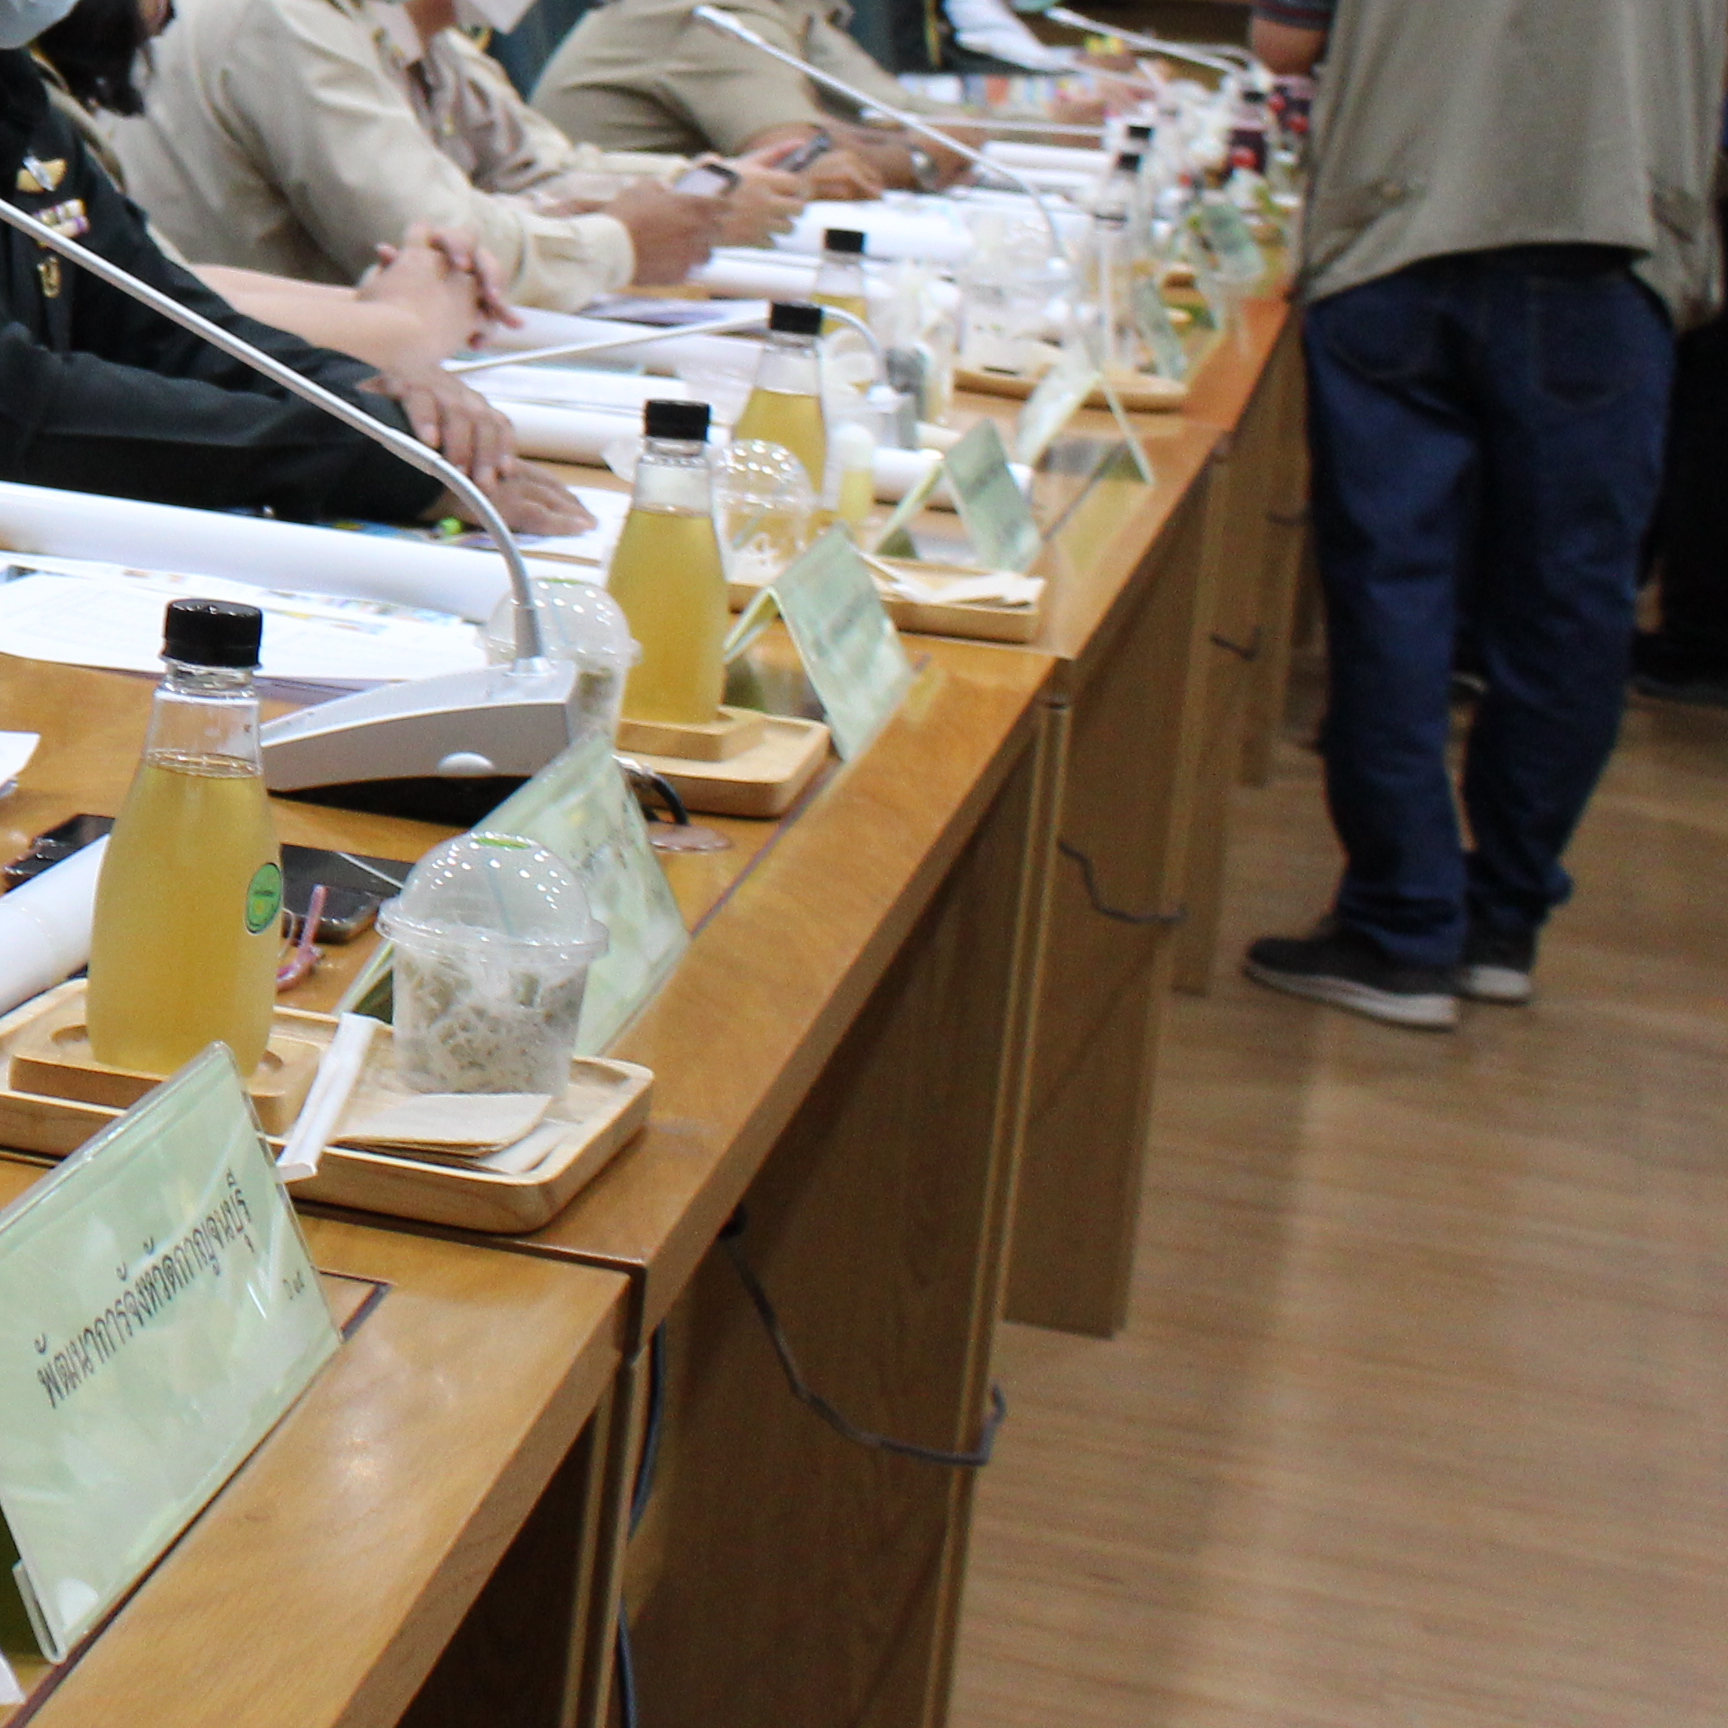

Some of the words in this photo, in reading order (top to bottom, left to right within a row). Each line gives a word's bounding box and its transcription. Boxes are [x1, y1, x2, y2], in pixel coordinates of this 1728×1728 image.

[34, 1165, 258, 1410] พัฒนาการจังหวัดกาญจนบุรี
